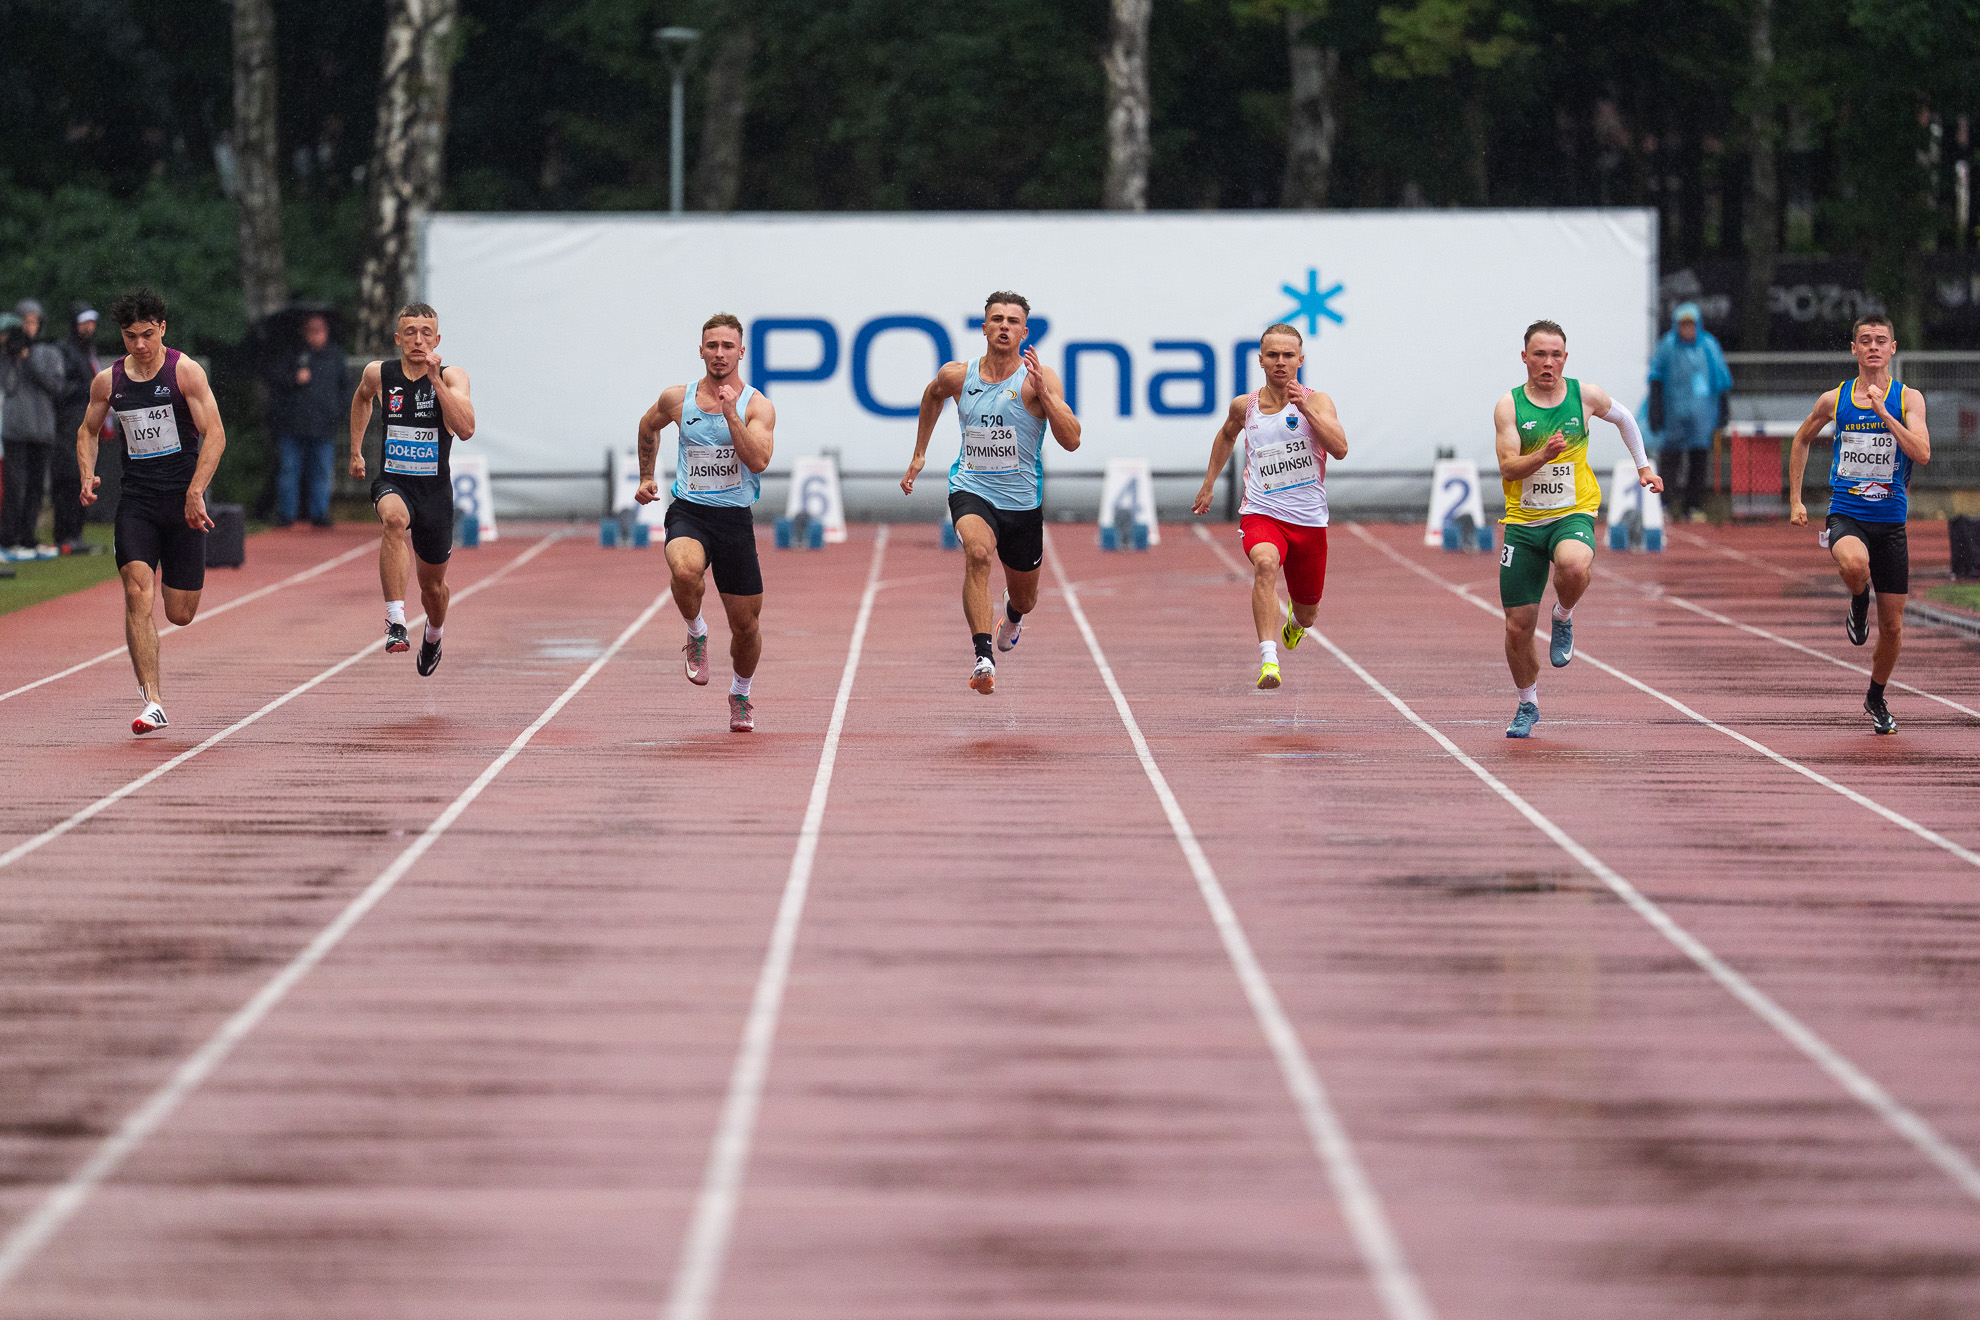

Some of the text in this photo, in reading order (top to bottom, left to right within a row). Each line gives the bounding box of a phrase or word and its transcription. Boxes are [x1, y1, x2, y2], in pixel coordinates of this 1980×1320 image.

[148, 408, 169, 420] 461
[981, 414, 1004, 428] 529
[1521, 420, 1537, 430] 4F
[134, 426, 160, 440] LYSY
[414, 430, 434, 441] 370
[991, 429, 1013, 440] 236
[1285, 440, 1307, 454] 531
[1871, 437, 1892, 448] 103
[388, 444, 434, 460] DOŁĘGA
[715, 448, 736, 459] 237
[966, 443, 1016, 457] DYMIŃSKI
[1843, 450, 1891, 465] PROCEK
[689, 462, 738, 477] JASIŃSKI
[1259, 455, 1313, 478] KULPIŃSKI
[1552, 465, 1571, 476] 551
[453, 473, 479, 515] 8
[1532, 482, 1564, 494] PRUS
[1442, 478, 1471, 521] 2
[1501, 546, 1509, 564] 3
